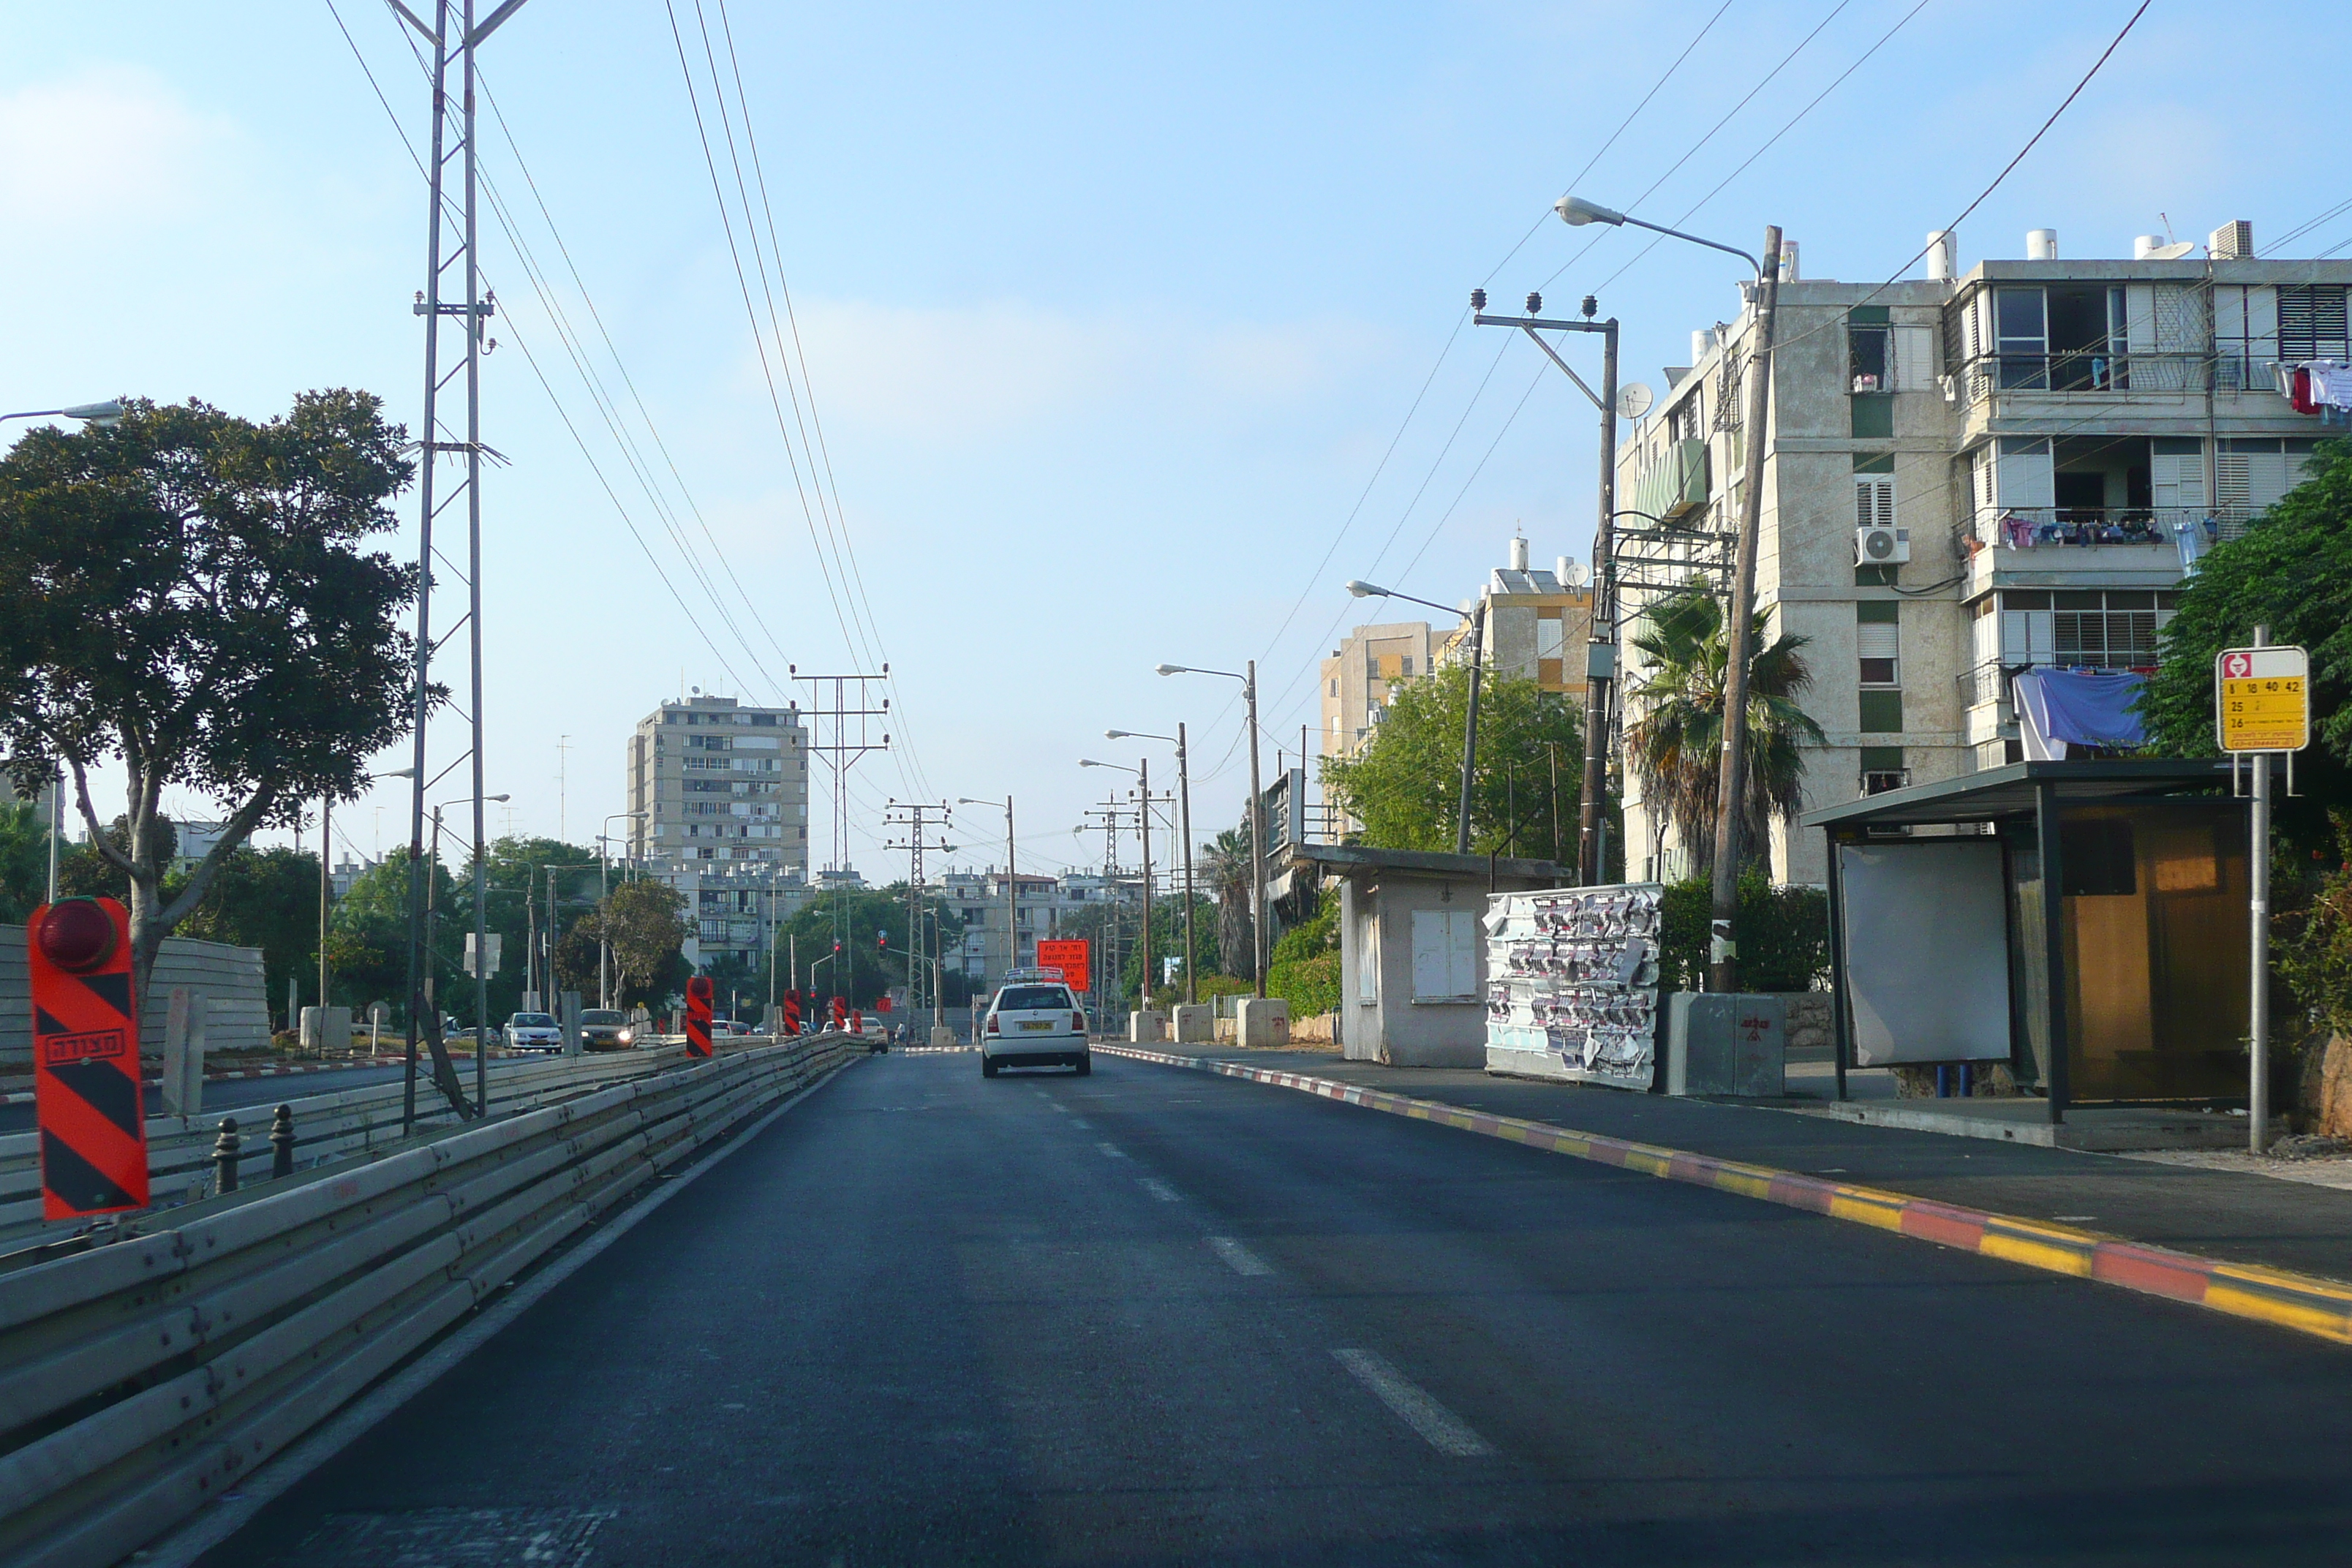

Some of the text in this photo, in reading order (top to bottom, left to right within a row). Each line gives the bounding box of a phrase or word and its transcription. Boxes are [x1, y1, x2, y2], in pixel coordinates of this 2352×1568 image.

[2247, 683, 2258, 693] 18
[2266, 682, 2278, 691] 40
[2285, 682, 2299, 692] 42
[2231, 701, 2243, 712] 25
[2231, 718, 2243, 728] 26
